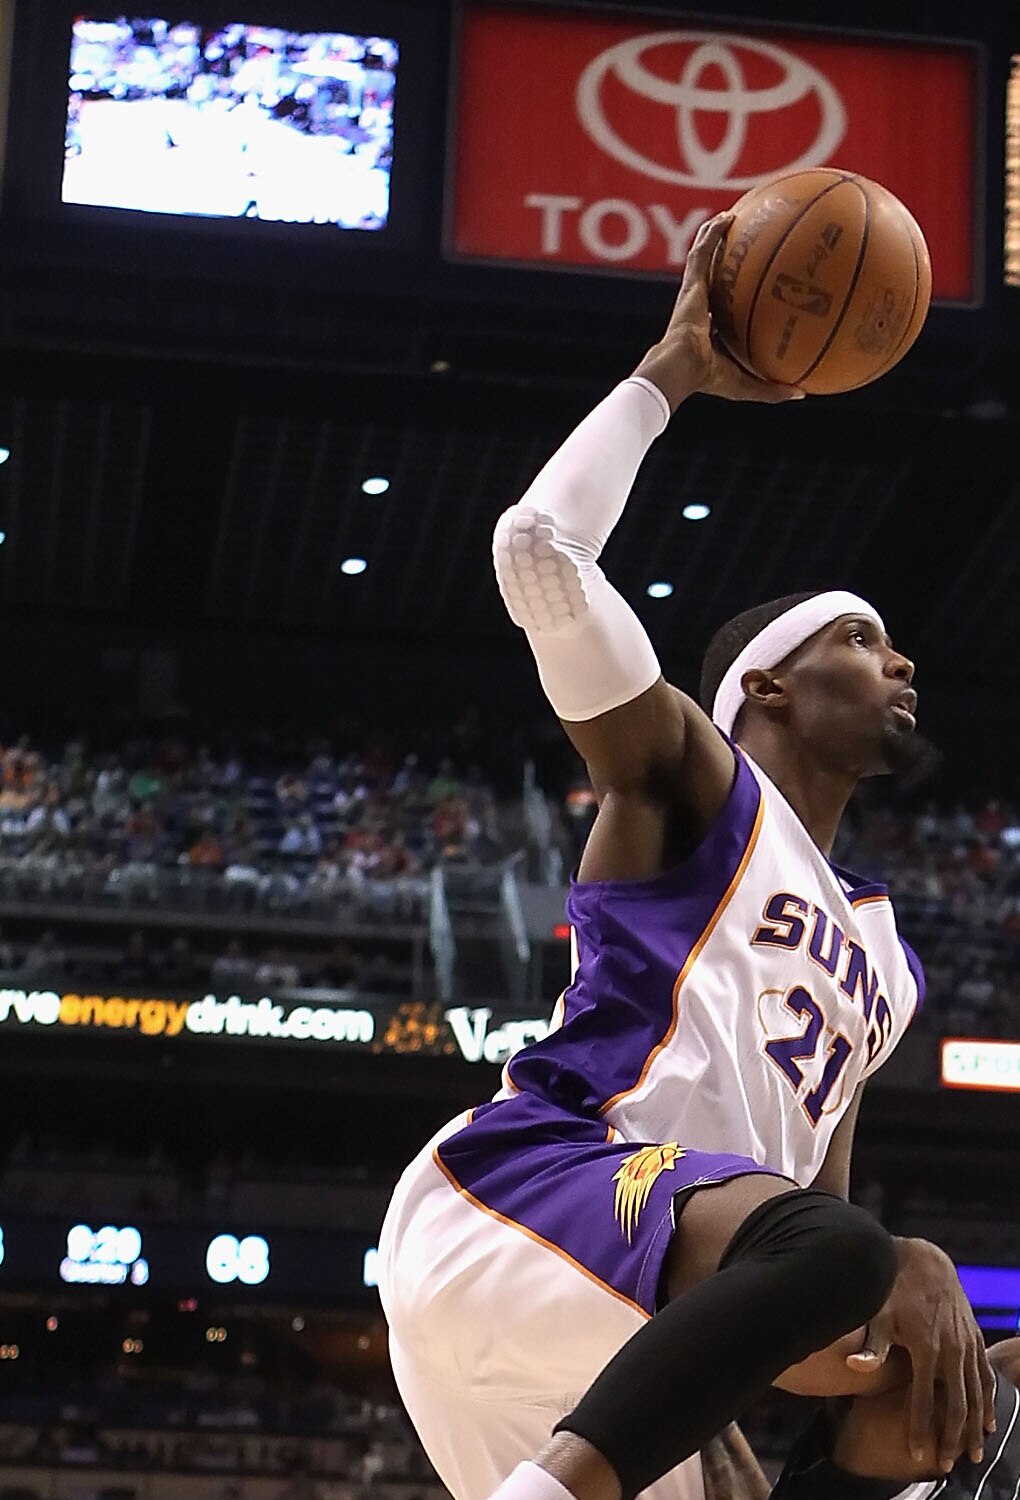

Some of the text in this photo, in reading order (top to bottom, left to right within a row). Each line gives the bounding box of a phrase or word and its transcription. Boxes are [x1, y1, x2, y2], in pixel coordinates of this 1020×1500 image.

[524, 192, 712, 265] TOY
[750, 890, 894, 1071] SUNS
[761, 985, 854, 1130] 21
